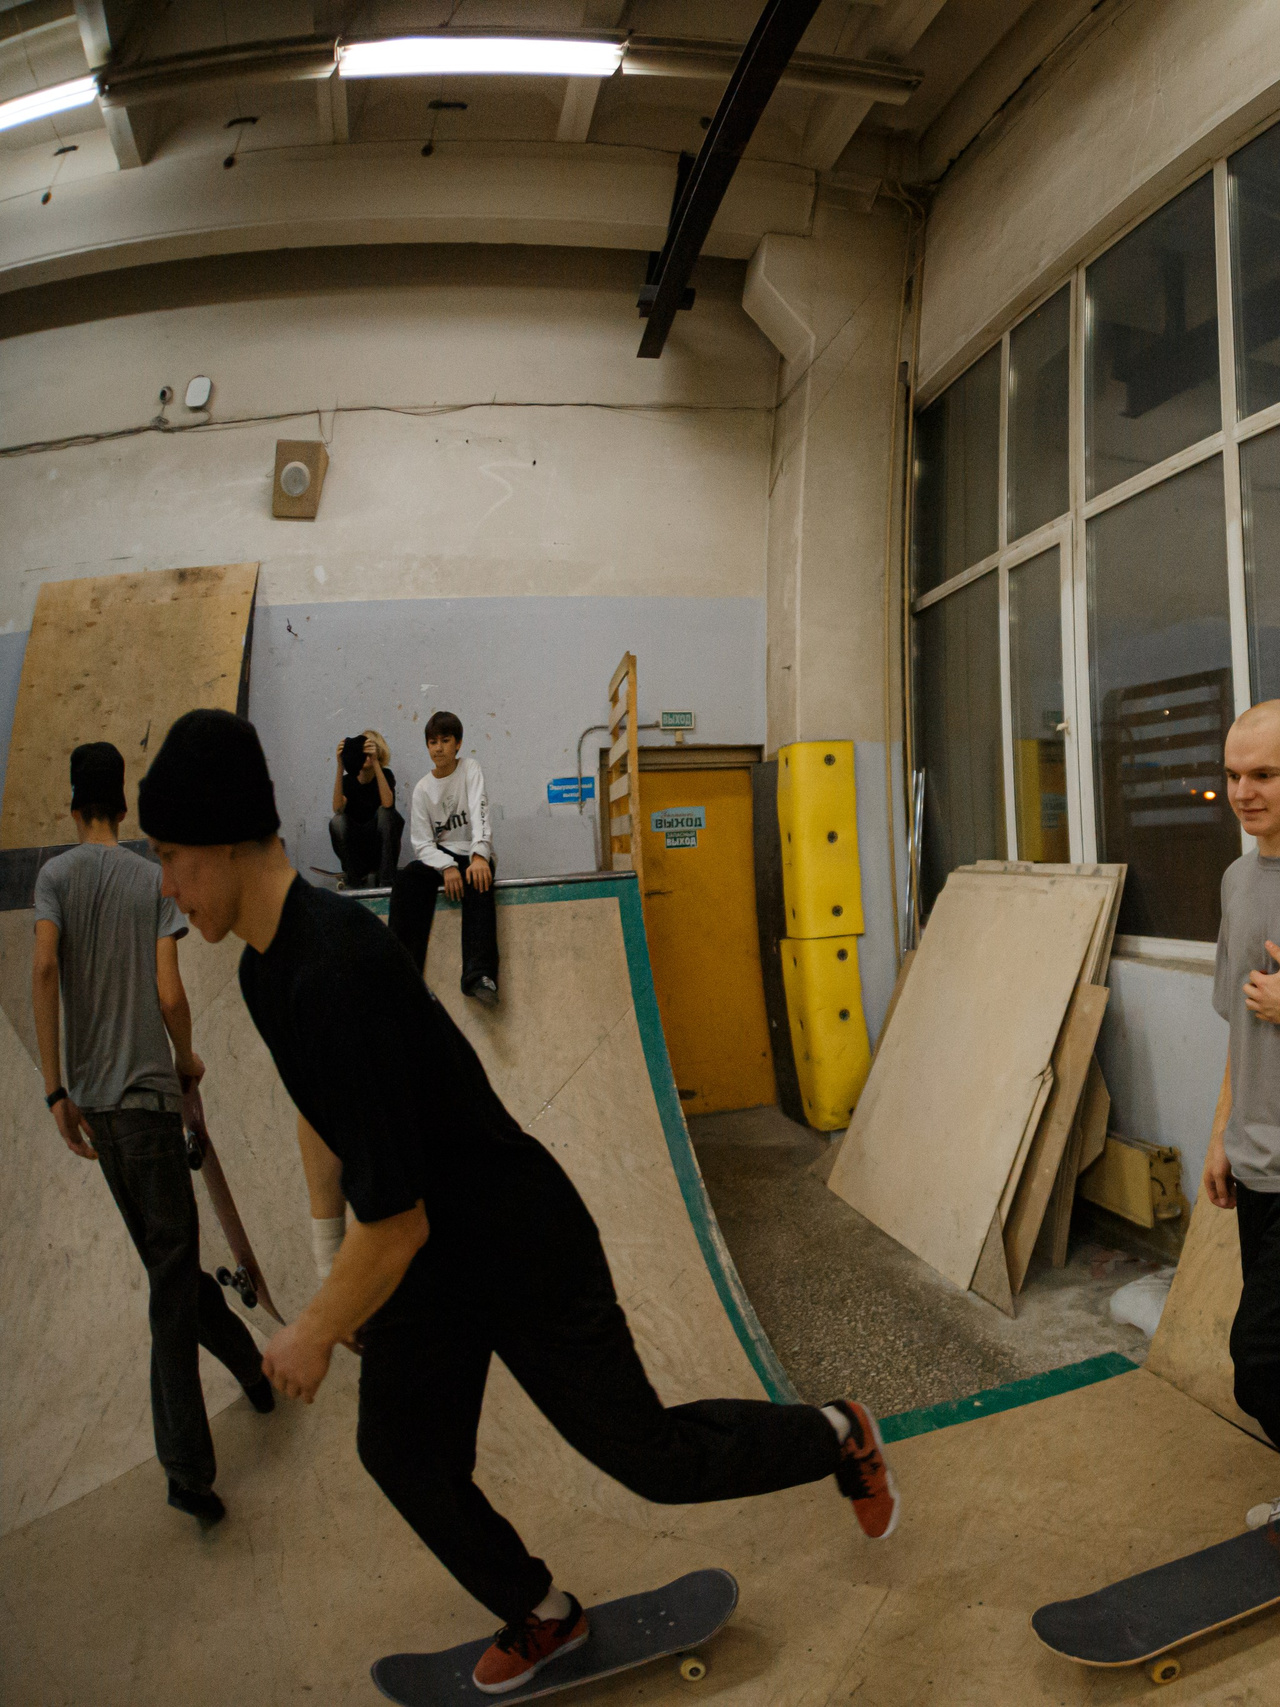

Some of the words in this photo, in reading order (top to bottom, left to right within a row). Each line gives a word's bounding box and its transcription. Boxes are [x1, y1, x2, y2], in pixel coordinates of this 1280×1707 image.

[663, 713, 691, 725] ВЫХОД
[655, 817, 703, 829] ВЫХОД
[666, 836, 697, 848] ВЫХОД
